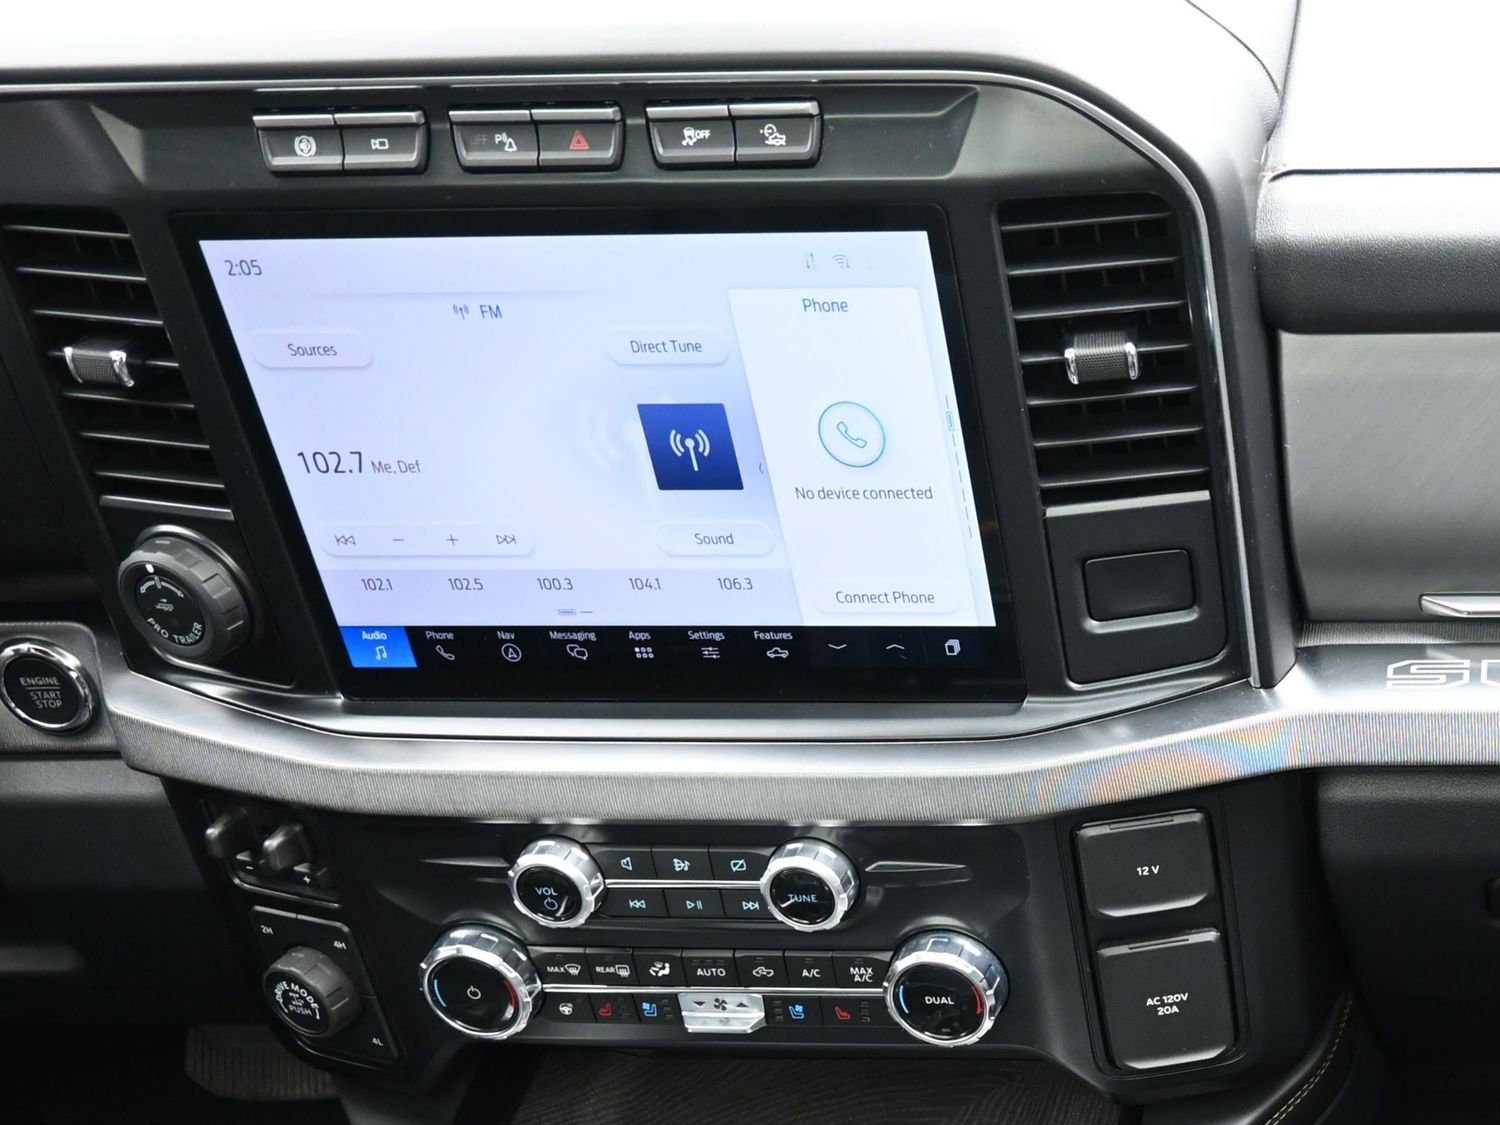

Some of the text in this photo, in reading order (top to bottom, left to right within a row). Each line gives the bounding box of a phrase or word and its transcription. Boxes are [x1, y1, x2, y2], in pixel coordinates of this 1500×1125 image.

[694, 129, 711, 140] OFF
[224, 259, 263, 277] 2:05
[479, 304, 503, 319] FM
[801, 298, 849, 313] Phone
[287, 343, 338, 357] Sources
[630, 339, 703, 354] Direct Tune
[297, 450, 364, 475] 102.7
[794, 486, 934, 501] No device connected
[694, 531, 735, 546] Sound
[361, 577, 394, 592] 102.1
[448, 577, 484, 592] 102.5
[537, 577, 574, 592] 100.3
[629, 577, 662, 591] 104.1
[717, 577, 753, 591] 106.3
[835, 591, 935, 605] Connect Phone
[147, 617, 203, 645] PRO TRAILER
[361, 630, 388, 641] Audio
[425, 630, 454, 641] Phone
[497, 630, 515, 641] Nav
[549, 630, 597, 642] Messaging
[628, 630, 651, 642] Apps
[687, 630, 725, 642] Settings
[753, 630, 793, 641] Features
[20, 677, 59, 687] ENGINE
[30, 691, 61, 701] START
[36, 700, 63, 710] STOP
[1136, 865, 1160, 877] 12 V
[535, 887, 558, 897] VOL
[786, 893, 818, 903] TUNE
[260, 925, 274, 935] 2H
[546, 966, 566, 974] MAX
[595, 966, 616, 974] REAR
[696, 967, 726, 977] AUTO
[801, 967, 821, 978] A/C
[850, 967, 873, 976] MAX
[854, 974, 873, 984] A/C
[290, 982, 320, 1009] MODE
[925, 995, 955, 1006] DUAL
[1146, 993, 1189, 1006] AC 120V
[1157, 1005, 1179, 1016] 20A
